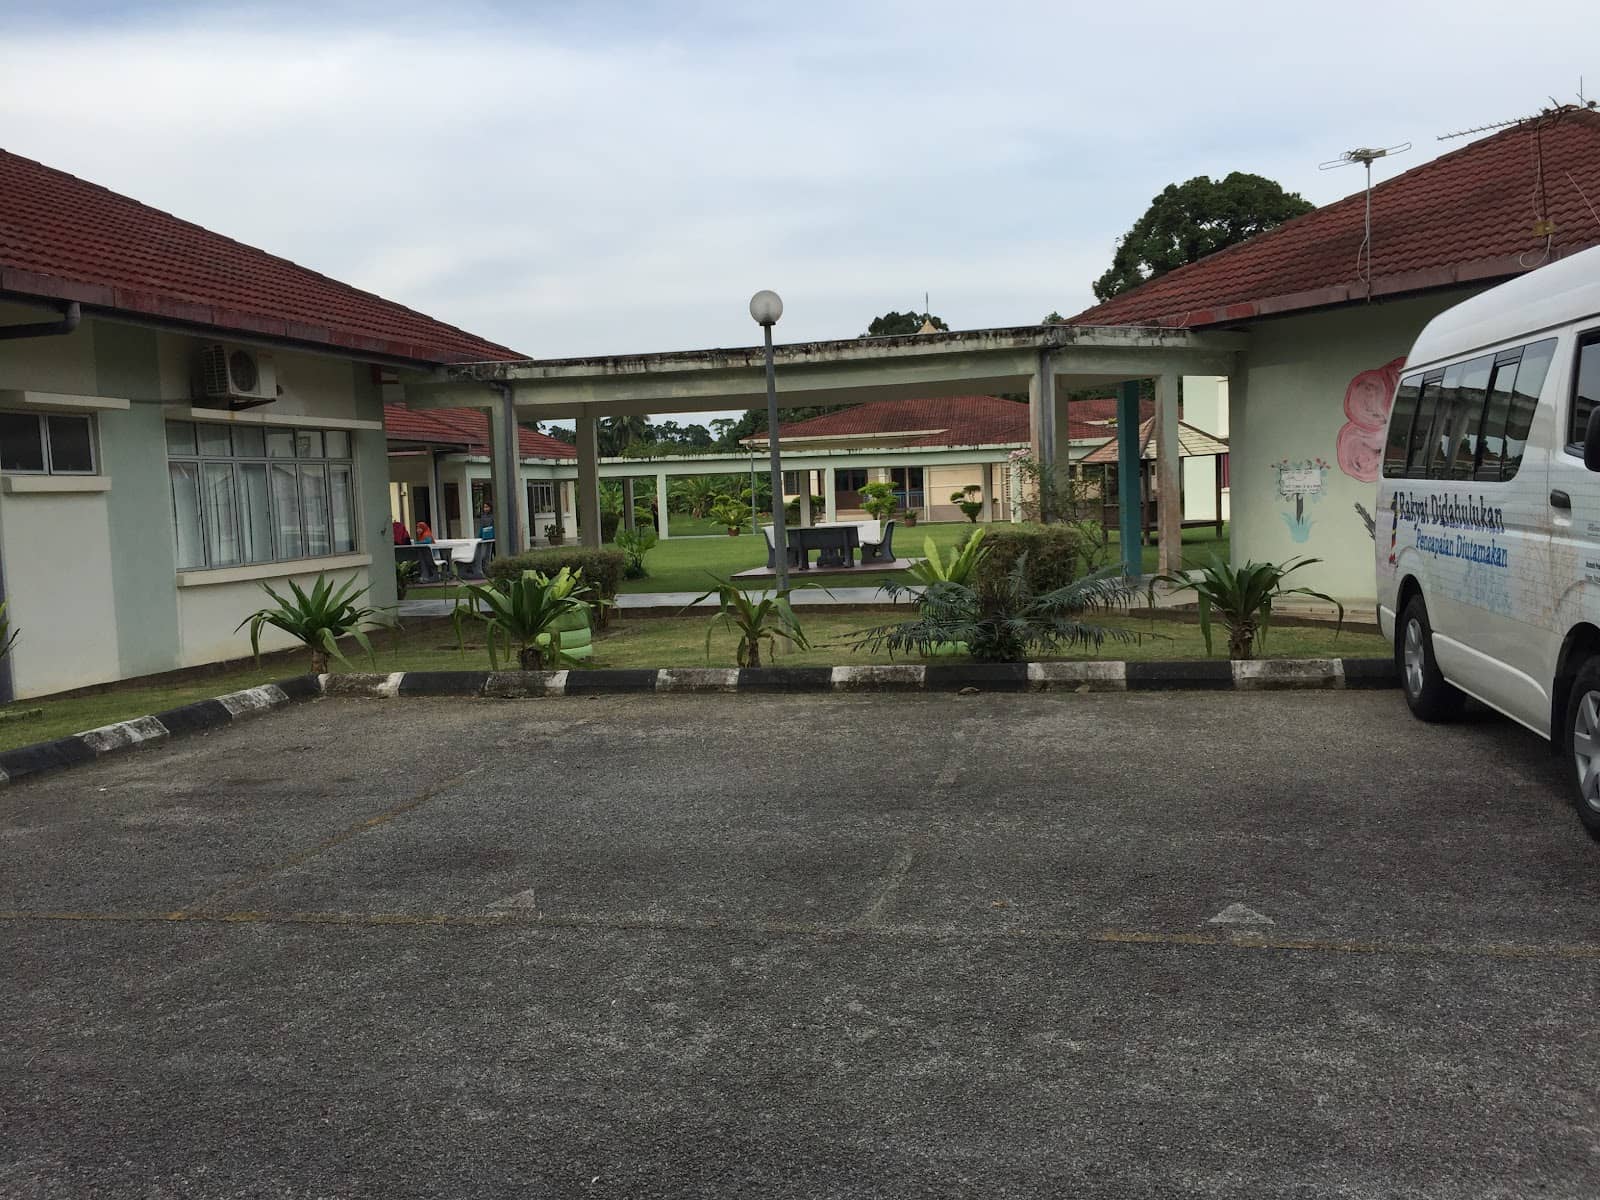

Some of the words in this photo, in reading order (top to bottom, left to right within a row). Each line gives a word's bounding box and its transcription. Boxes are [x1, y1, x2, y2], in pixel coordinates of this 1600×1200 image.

[1431, 493, 1505, 532] Didahulukan
[1416, 528, 1454, 559] Pencapaian
[1456, 534, 1508, 568] Diutamakan
